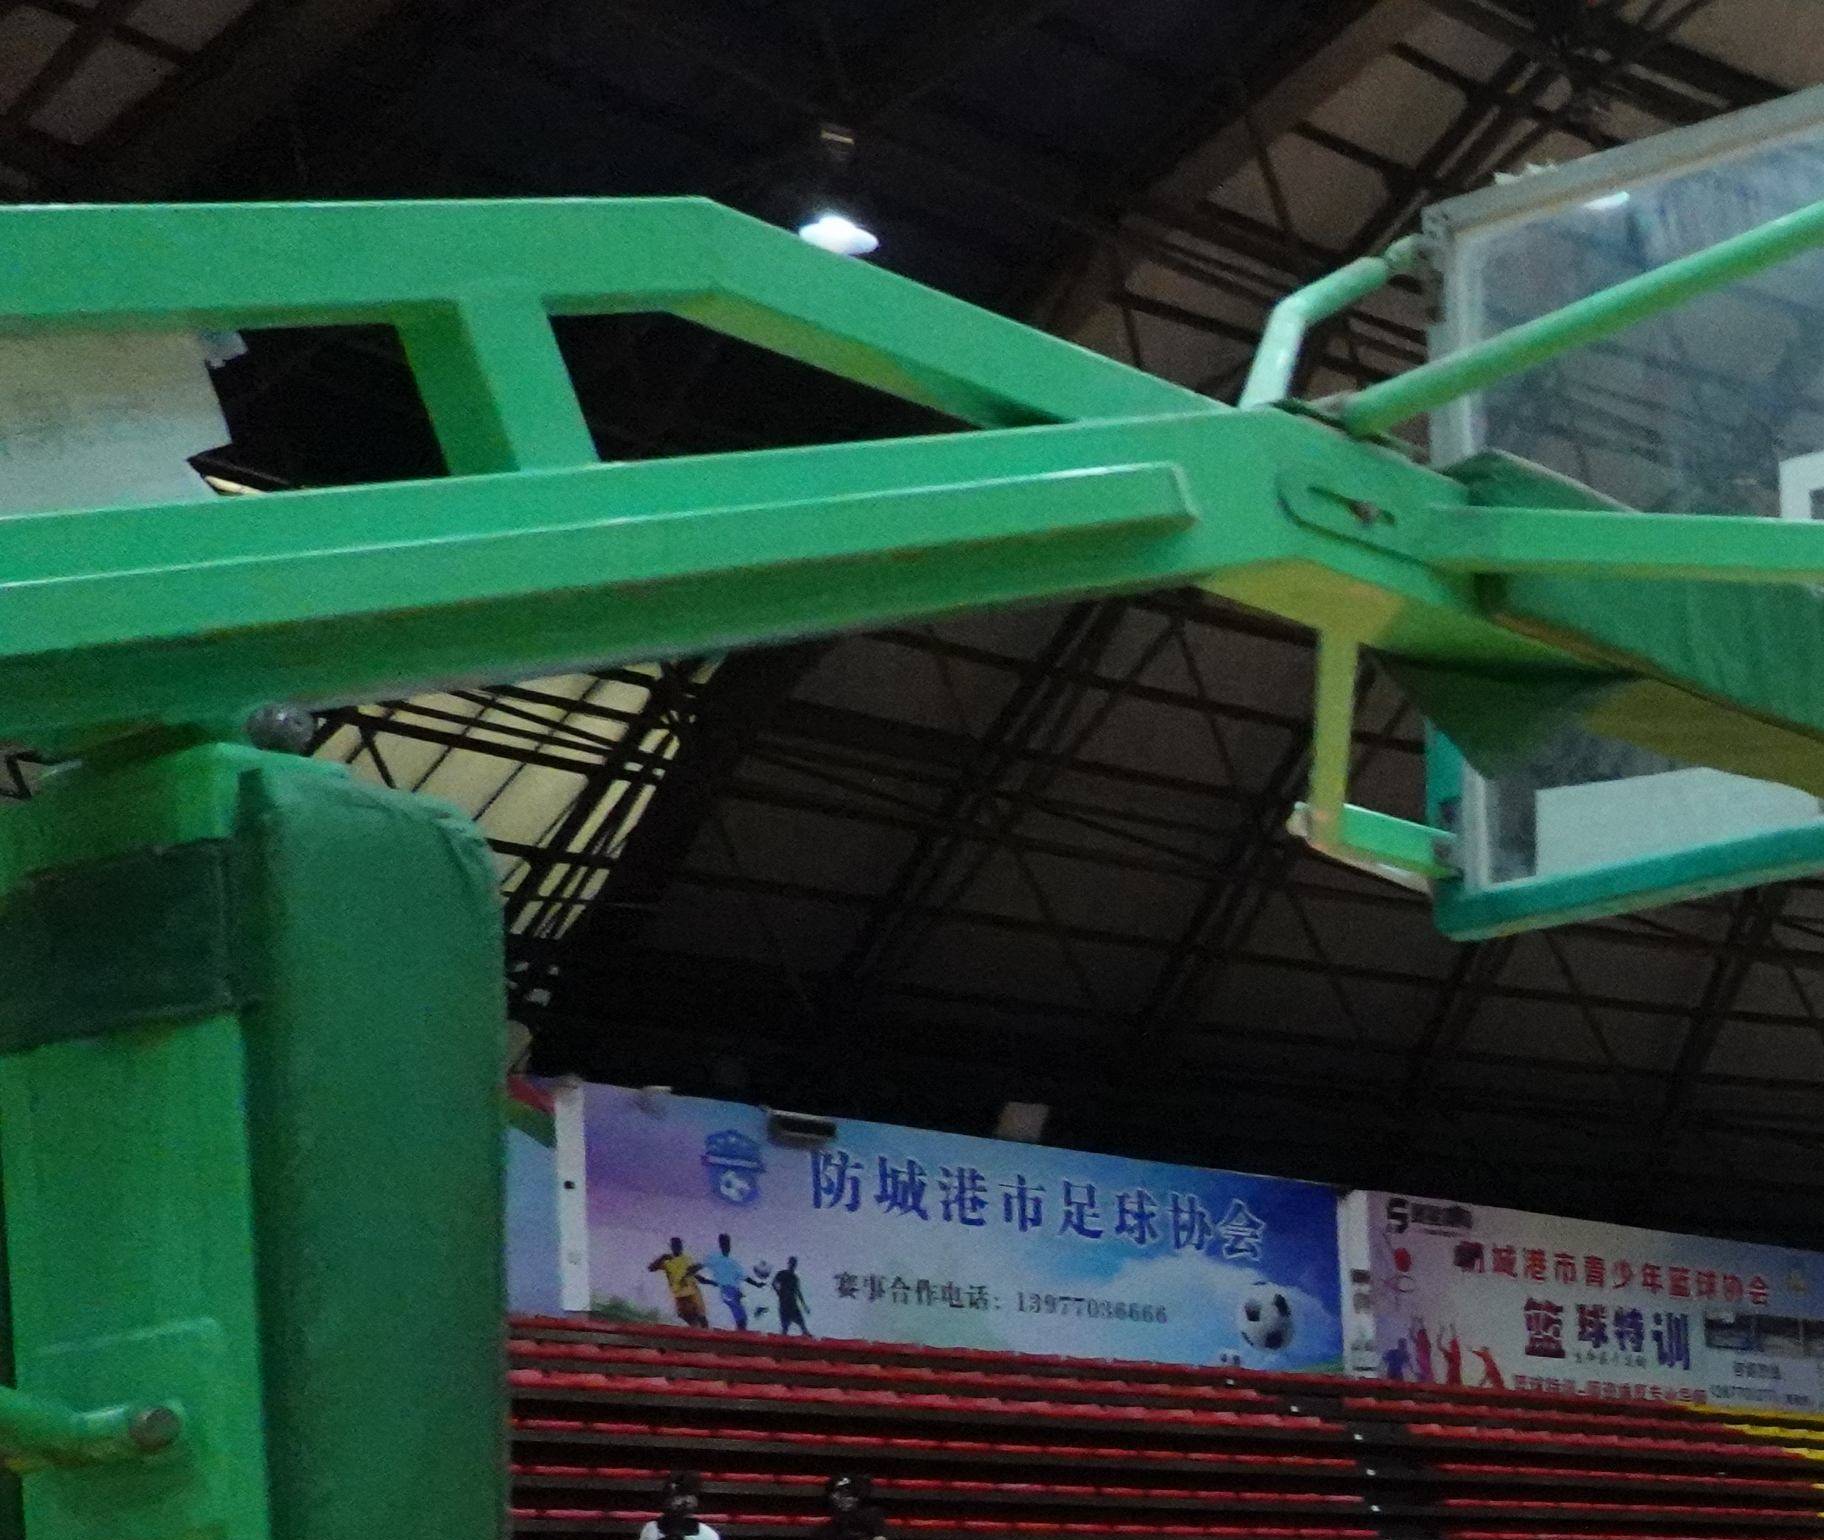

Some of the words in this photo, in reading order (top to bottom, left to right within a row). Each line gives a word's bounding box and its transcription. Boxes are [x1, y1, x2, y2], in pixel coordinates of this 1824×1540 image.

[809, 1148, 1268, 1261] 防城港市足球协会
